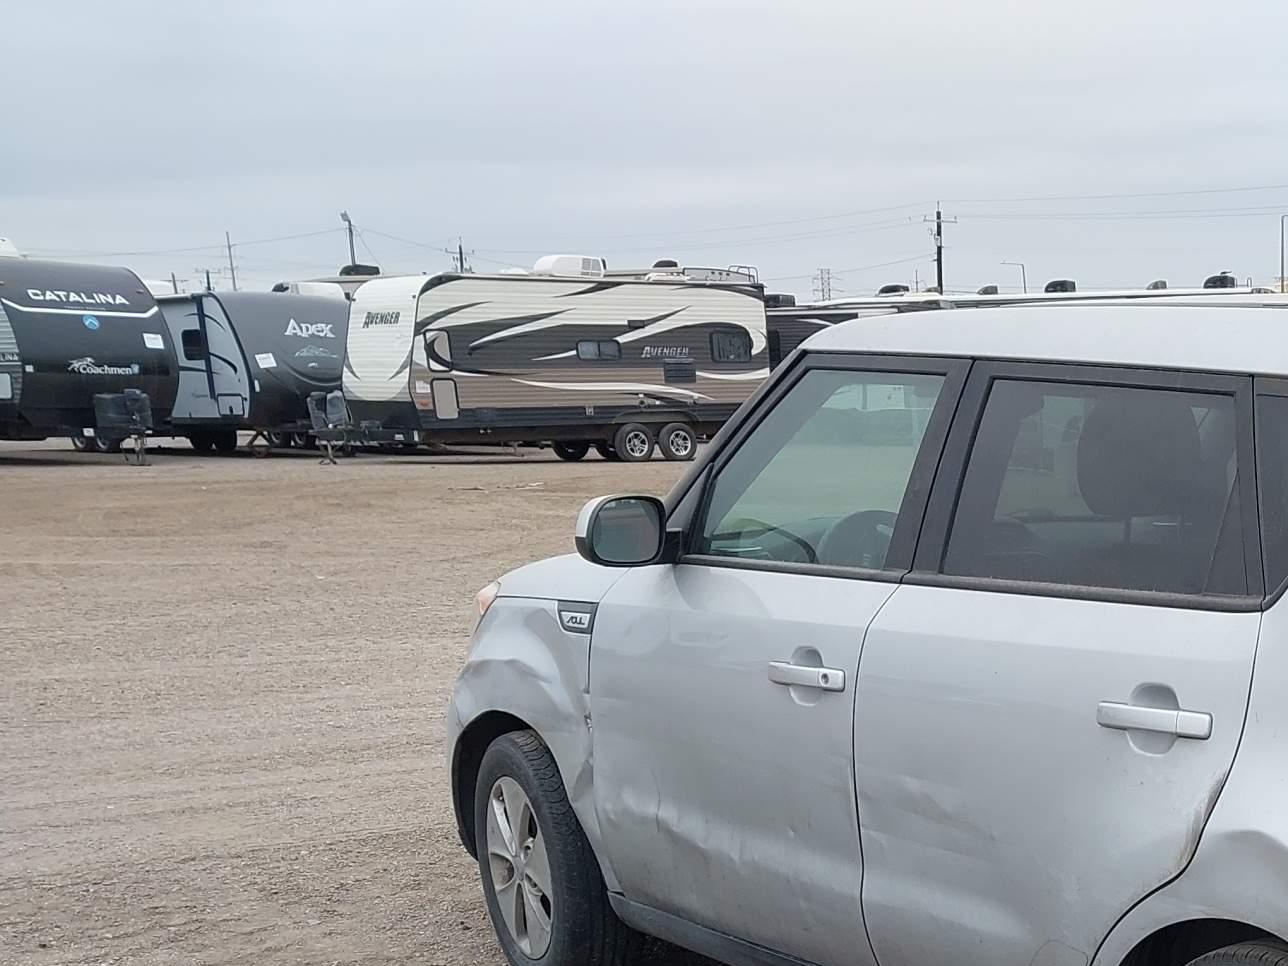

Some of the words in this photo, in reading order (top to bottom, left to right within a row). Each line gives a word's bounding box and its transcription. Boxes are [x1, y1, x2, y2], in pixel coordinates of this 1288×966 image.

[27, 289, 130, 305] CATALINA
[284, 318, 336, 338] Apex
[362, 311, 400, 329] AVENGER
[641, 346, 689, 358] AVENGER
[79, 364, 133, 375] Coachmen
